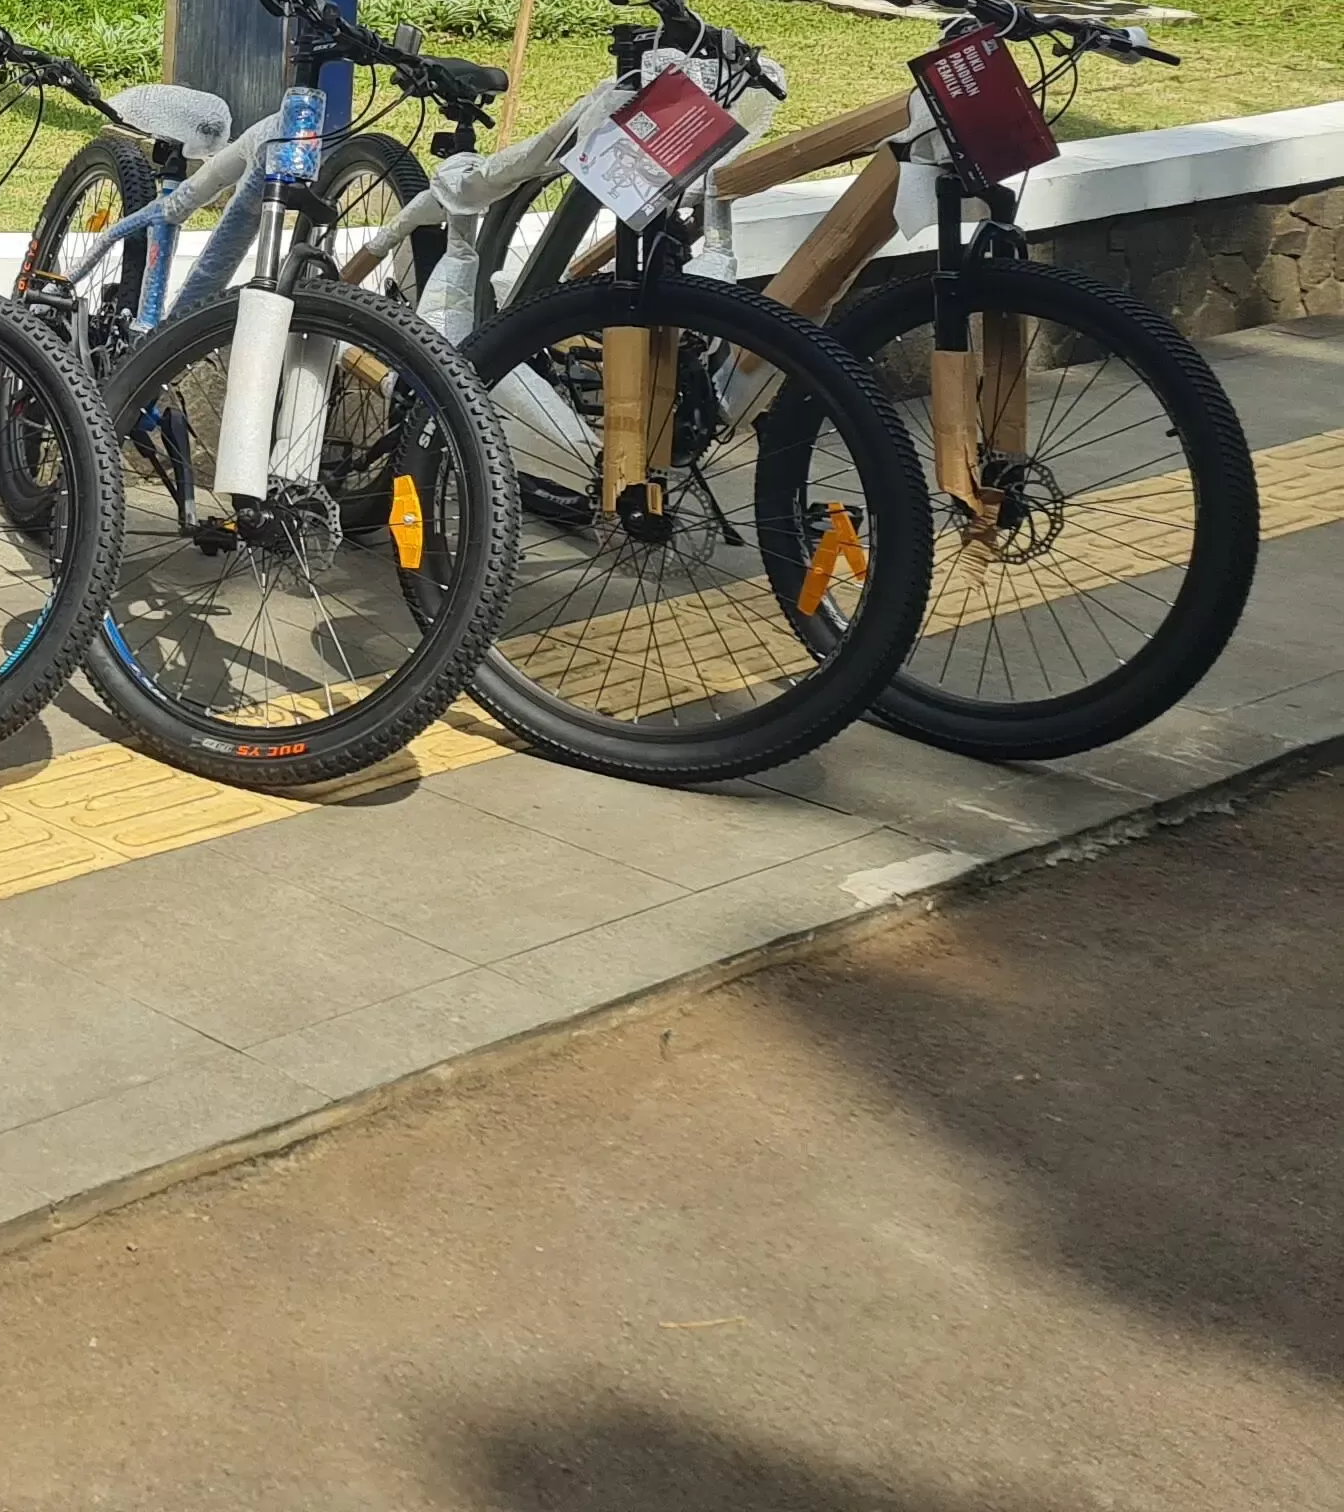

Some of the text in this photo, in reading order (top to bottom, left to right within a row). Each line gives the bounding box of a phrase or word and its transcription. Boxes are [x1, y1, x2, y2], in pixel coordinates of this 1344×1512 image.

[934, 57, 964, 99] PEMILIK
[948, 51, 980, 97] PANDUAN
[963, 44, 987, 73] BUKU
